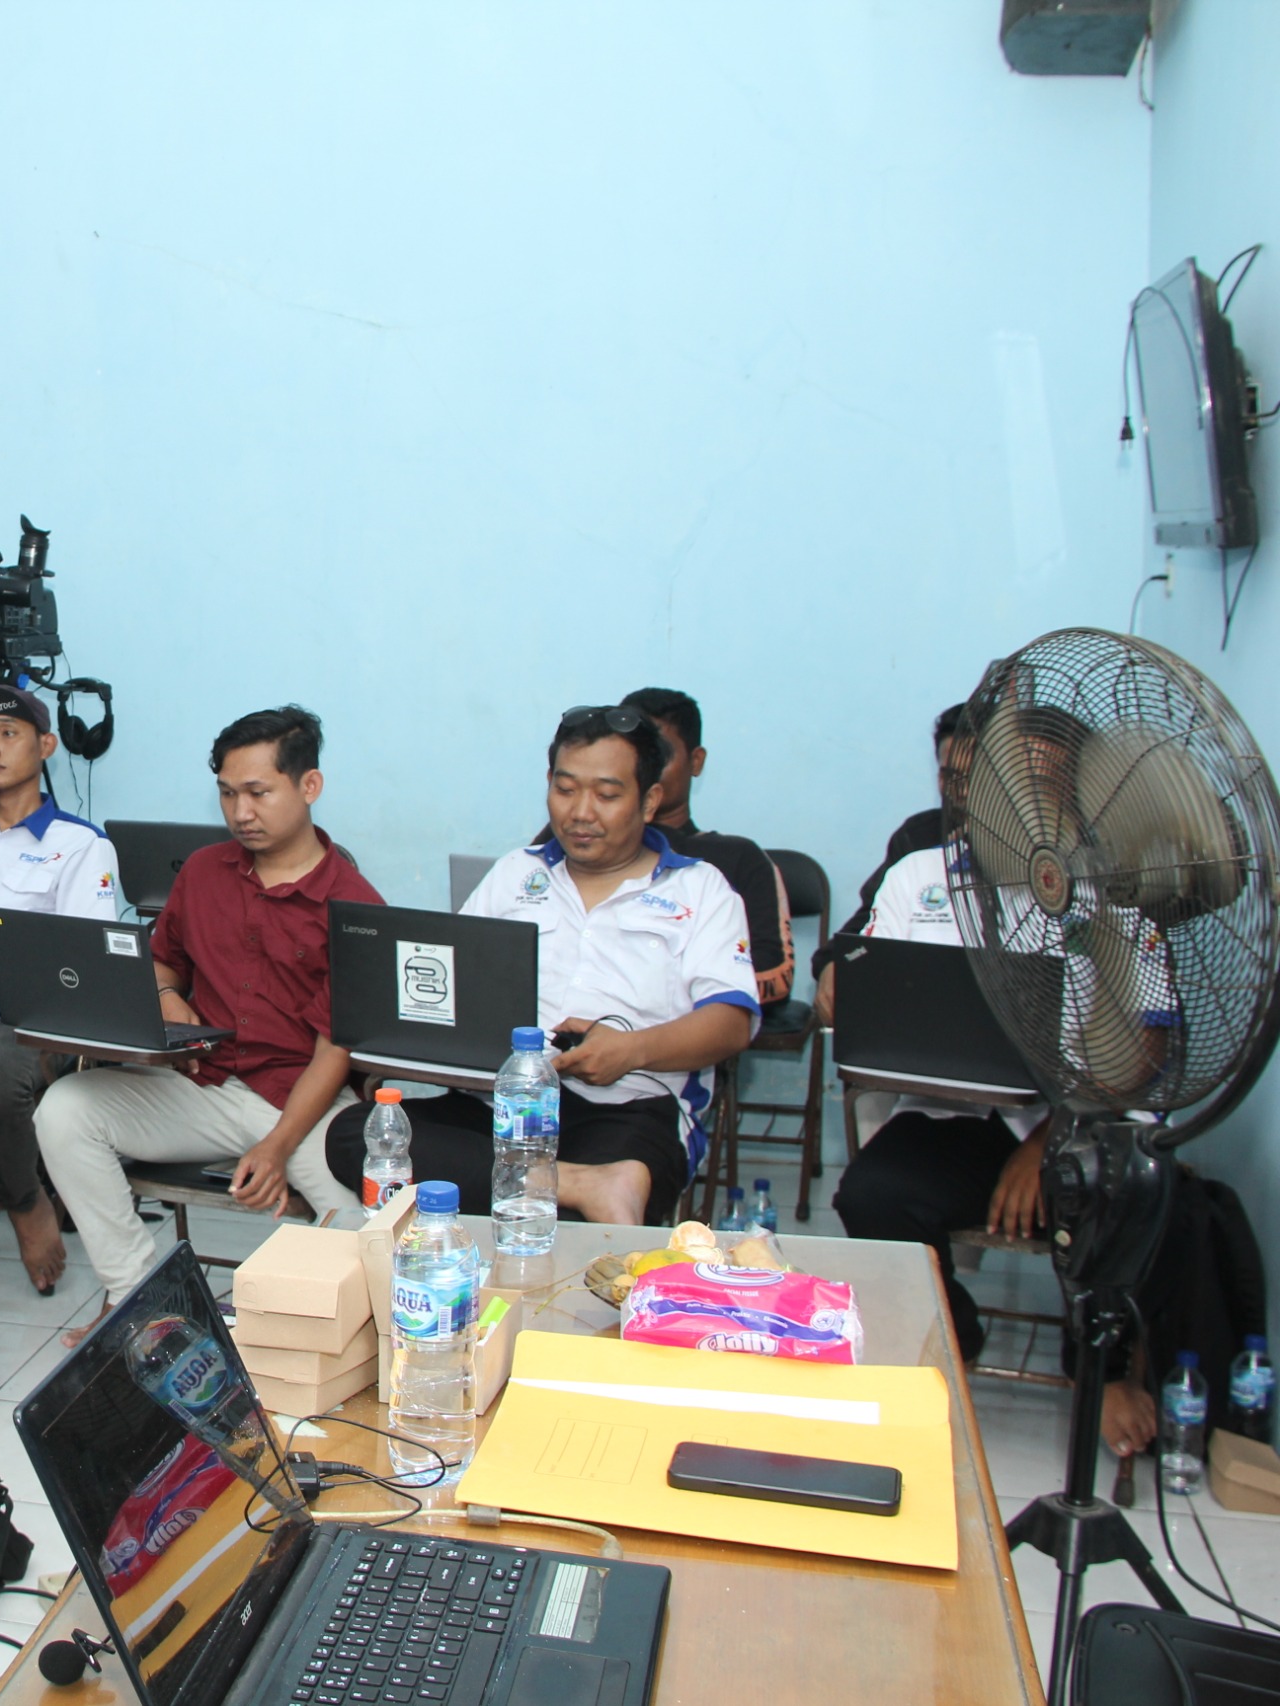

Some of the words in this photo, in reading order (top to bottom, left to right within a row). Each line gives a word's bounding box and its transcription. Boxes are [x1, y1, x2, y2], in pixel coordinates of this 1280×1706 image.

[640, 893, 677, 913] SPMI
[342, 924, 378, 936] Lenovo
[240, 1600, 253, 1626] acer
